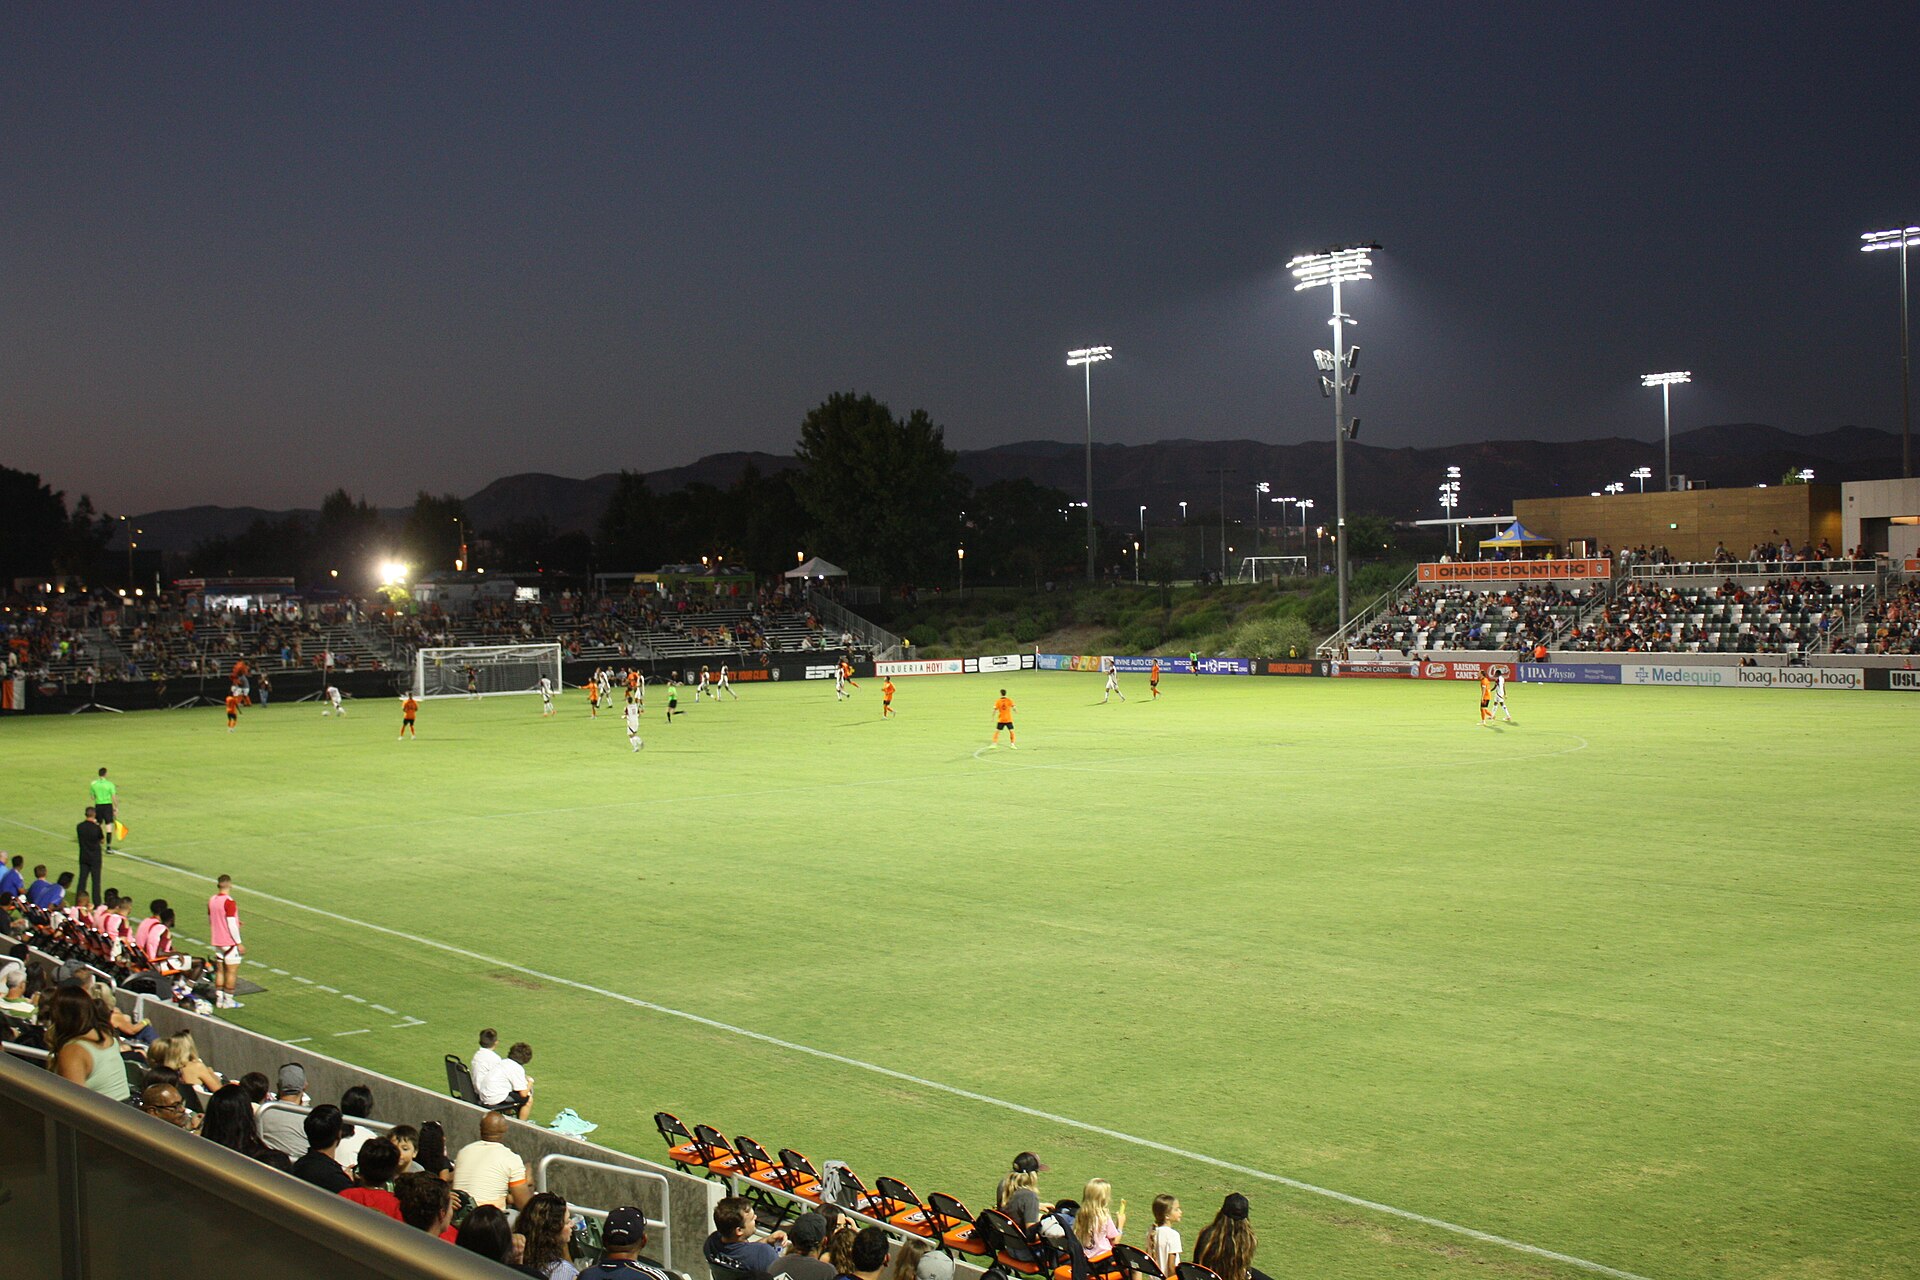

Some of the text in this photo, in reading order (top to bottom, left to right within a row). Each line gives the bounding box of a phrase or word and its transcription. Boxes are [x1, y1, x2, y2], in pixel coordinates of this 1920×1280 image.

[1439, 563, 1585, 577] ORANGE COUNTY SC
[879, 662, 943, 674] TAQUERIA HOY!
[1453, 663, 1480, 671] RAISING
[1527, 667, 1576, 682] IPA Physio
[1652, 668, 1722, 686] Medequip
